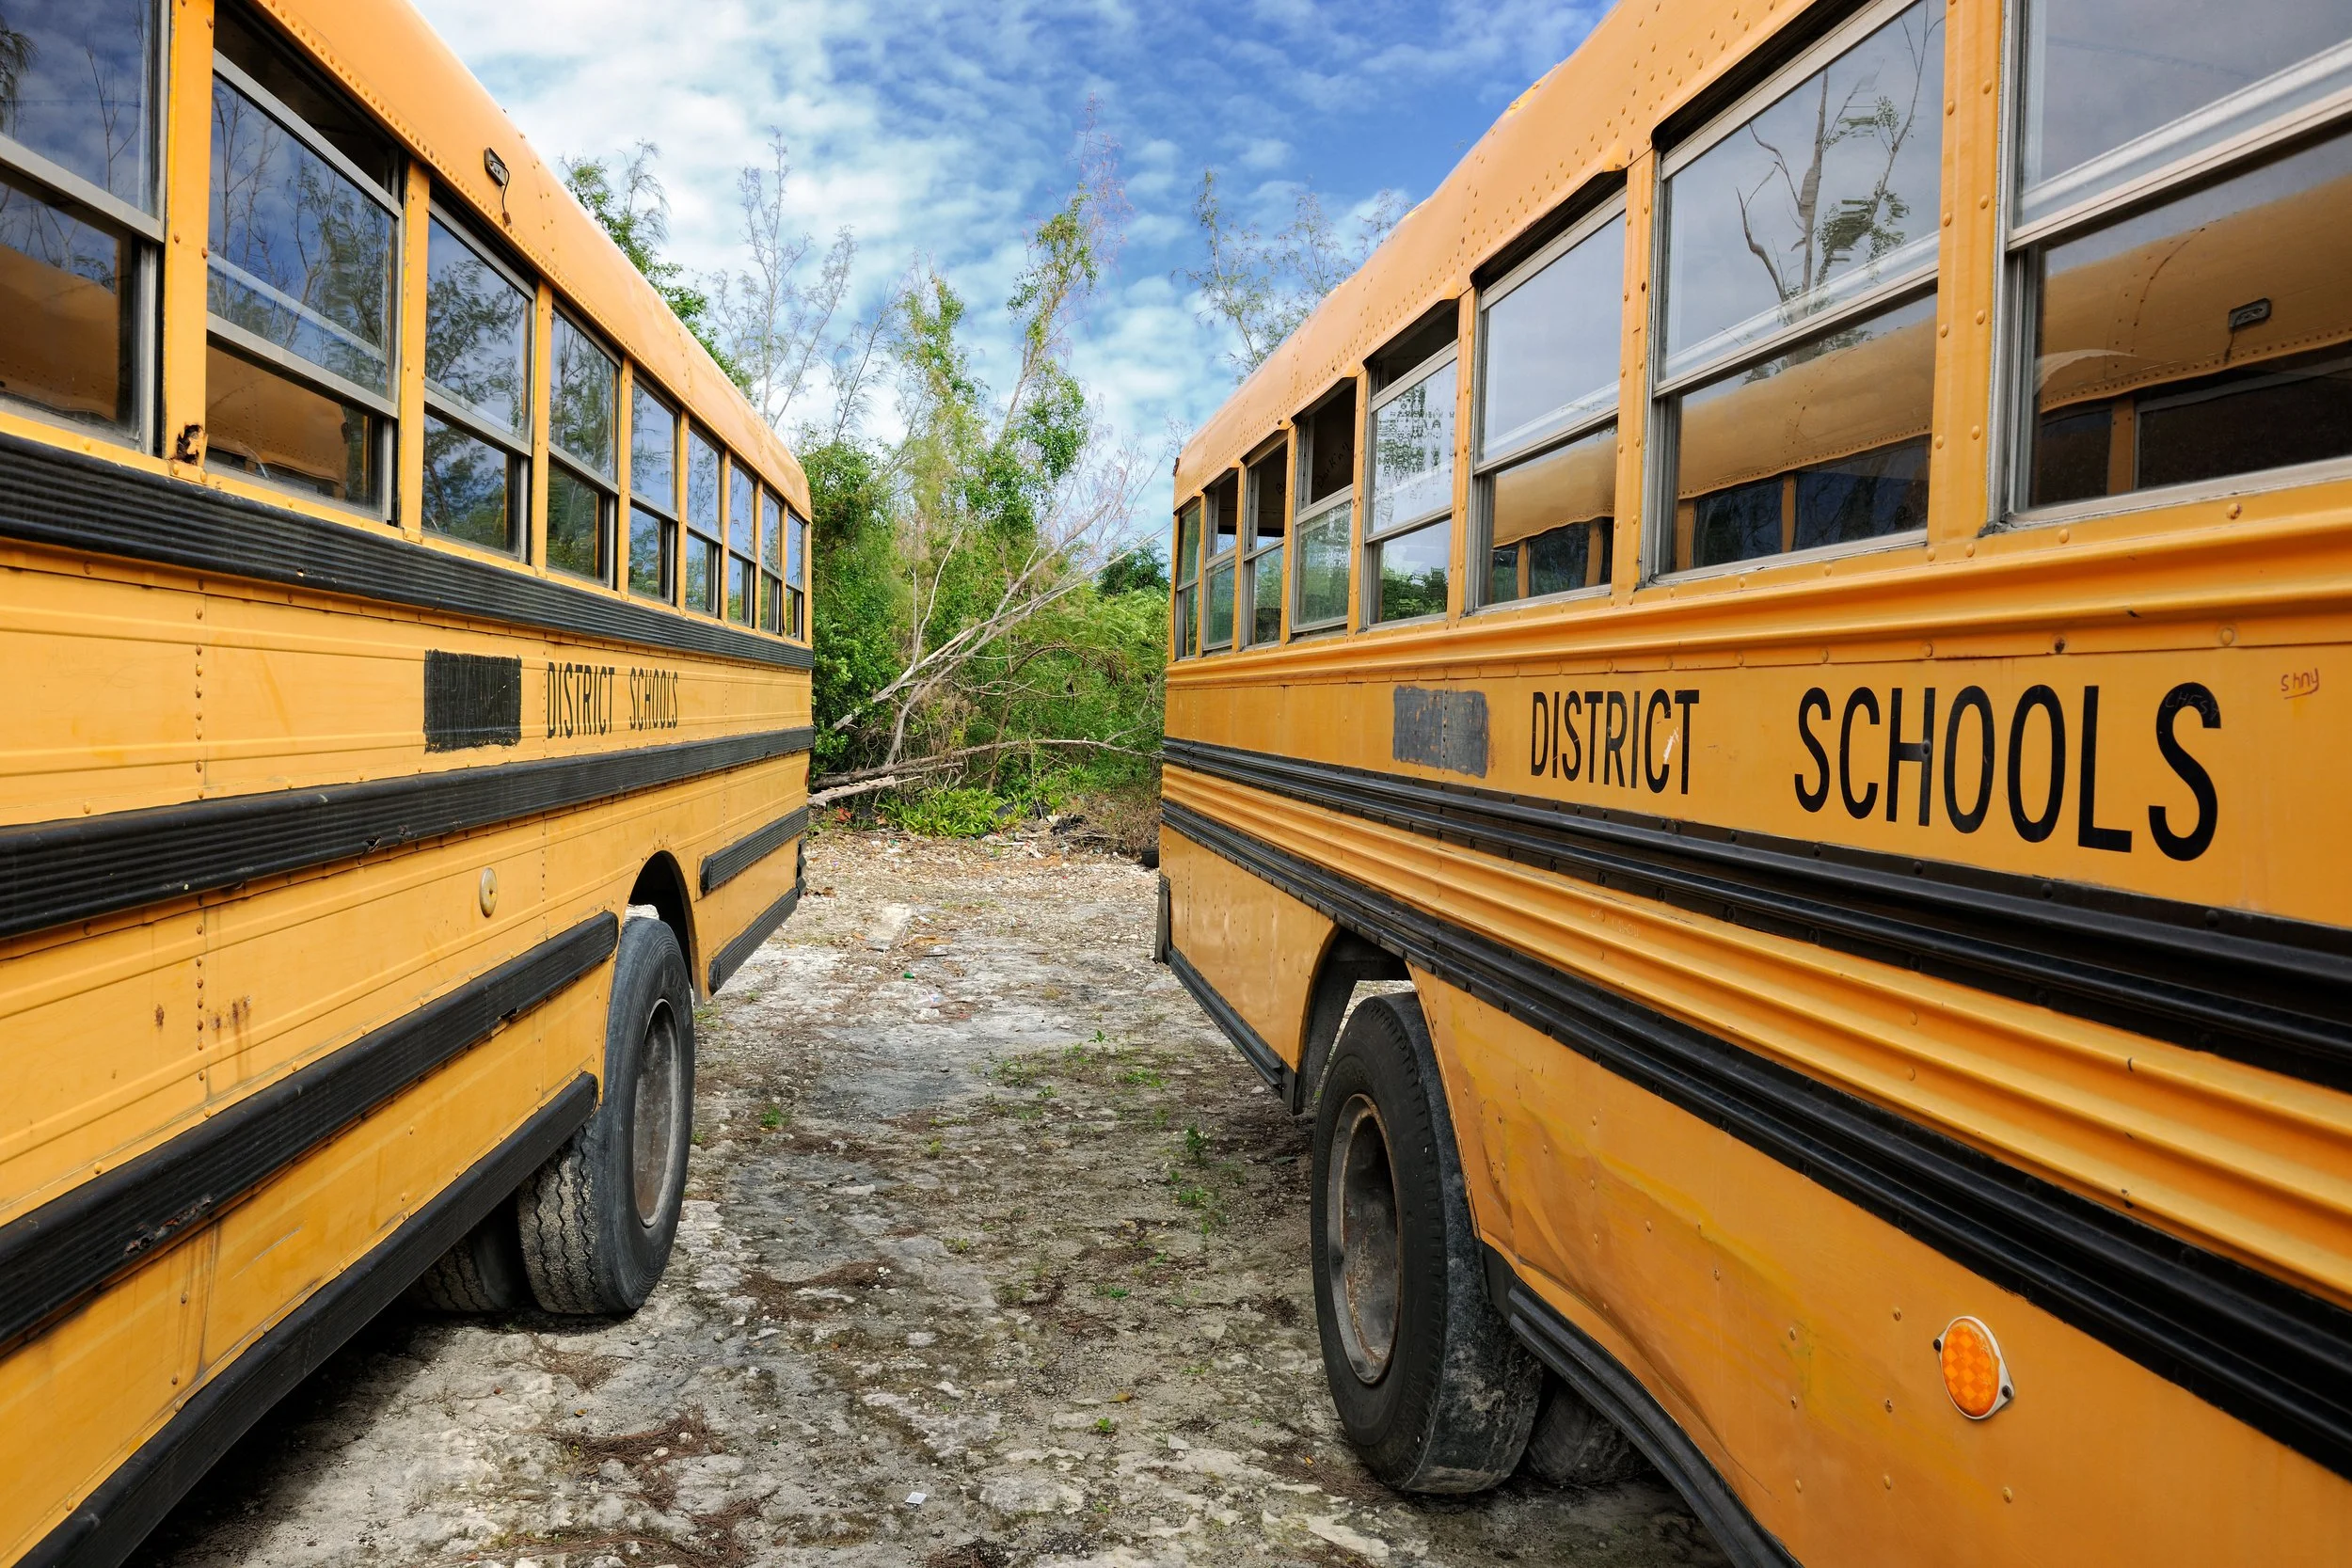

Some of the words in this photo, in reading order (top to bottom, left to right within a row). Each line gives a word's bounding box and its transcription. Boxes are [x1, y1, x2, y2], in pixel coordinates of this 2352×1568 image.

[547, 661, 614, 738] DISTRICT
[629, 667, 678, 731] SCHOOLS
[1531, 689, 1699, 795] DISTRICT
[1794, 682, 2221, 862] SCHOOLS
